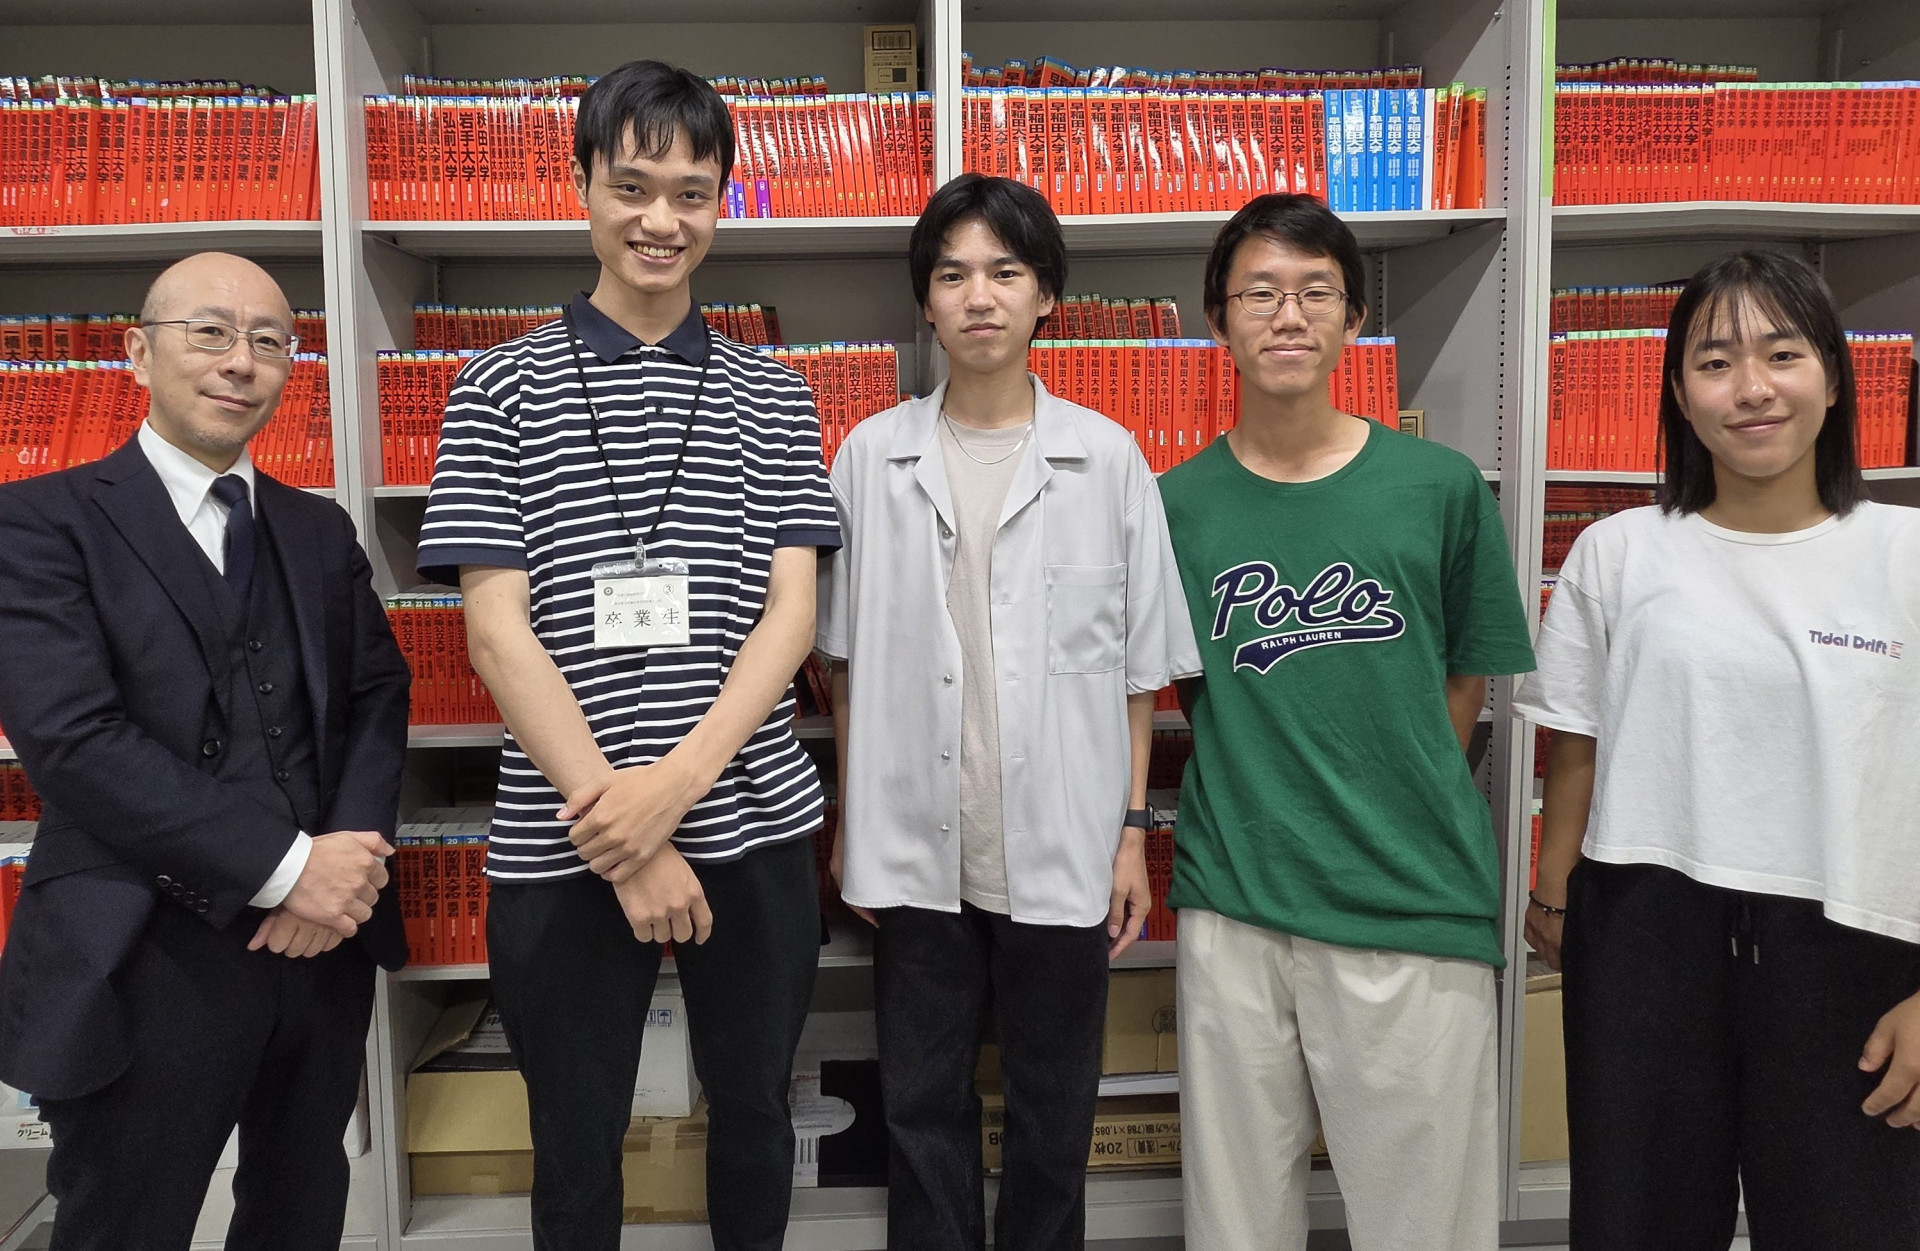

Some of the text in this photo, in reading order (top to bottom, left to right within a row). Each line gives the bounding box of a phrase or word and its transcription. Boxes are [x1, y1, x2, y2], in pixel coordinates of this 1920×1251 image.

[918, 107, 934, 157] 富山大学
[980, 102, 992, 153] 早稲田大学
[1029, 103, 1045, 154] 早稲田大学
[1051, 103, 1067, 154] 早稲田大学
[1111, 103, 1125, 153] 早稲田大学
[1269, 106, 1285, 154] 早稲田大学
[1290, 106, 1306, 154] 早稲田大学
[1311, 104, 1324, 145] 早稲田大学
[1387, 116, 1402, 154] 早稲田大学
[1407, 116, 1422, 154] 早稲田大学
[1561, 97, 1571, 146] 明治大学
[1580, 97, 1590, 146] 明治大学
[1591, 97, 1600, 146] 明治大学
[1603, 97, 1613, 138] 明治大学
[1615, 97, 1625, 146] 明治大学
[1626, 97, 1636, 146] 明治大学
[1643, 97, 1651, 138] 明治大学
[1653, 97, 1662, 146] 明治大学
[1663, 97, 1672, 146] 明治大学
[1673, 97, 1683, 146] 明治大学
[1684, 97, 1699, 146] 明治大学
[1702, 97, 1713, 137] 明治大学
[442, 112, 458, 181] 弘前大学
[459, 112, 476, 181] 岩手大学
[477, 112, 490, 181] 秋田大学
[533, 113, 548, 182] 山形大学
[850, 356, 862, 402] 大阪府立大学
[872, 356, 883, 397] 大阪市立大学
[884, 356, 895, 396] 大阪市立大学
[1075, 350, 1085, 396] 早稲田大学
[1091, 350, 1100, 396] 早稲田大学
[1109, 350, 1119, 397] 早稲田大学
[1131, 350, 1141, 397] 早稲田大学
[1160, 350, 1170, 397] 早稲田大学
[1179, 350, 1189, 397] 早稲田大学
[1198, 350, 1207, 397] 早稲田大学
[1223, 350, 1232, 397] 早稲田大学
[1344, 348, 1353, 395] 早稲田大学
[1366, 348, 1375, 394] 早稲田大学
[1385, 348, 1395, 394] 早稲田大学
[1552, 348, 1565, 396] 青山学院大学
[1625, 340, 1635, 390] 青山学院大学
[1643, 340, 1652, 390] 青山学院大学
[379, 365, 393, 417] 金沢大学
[402, 365, 416, 417] 福井大学
[416, 365, 430, 417] 福井大学
[430, 364, 445, 417] 浜松医科大学
[604, 608, 681, 628] 卒業生
[1211, 560, 1394, 640] Polo
[1261, 631, 1342, 650] RALPH LAUREN
[1809, 630, 1888, 655] Tidal Drift
[17, 1129, 48, 1137] クリーム
[1094, 1142, 1123, 1155] 20枚
